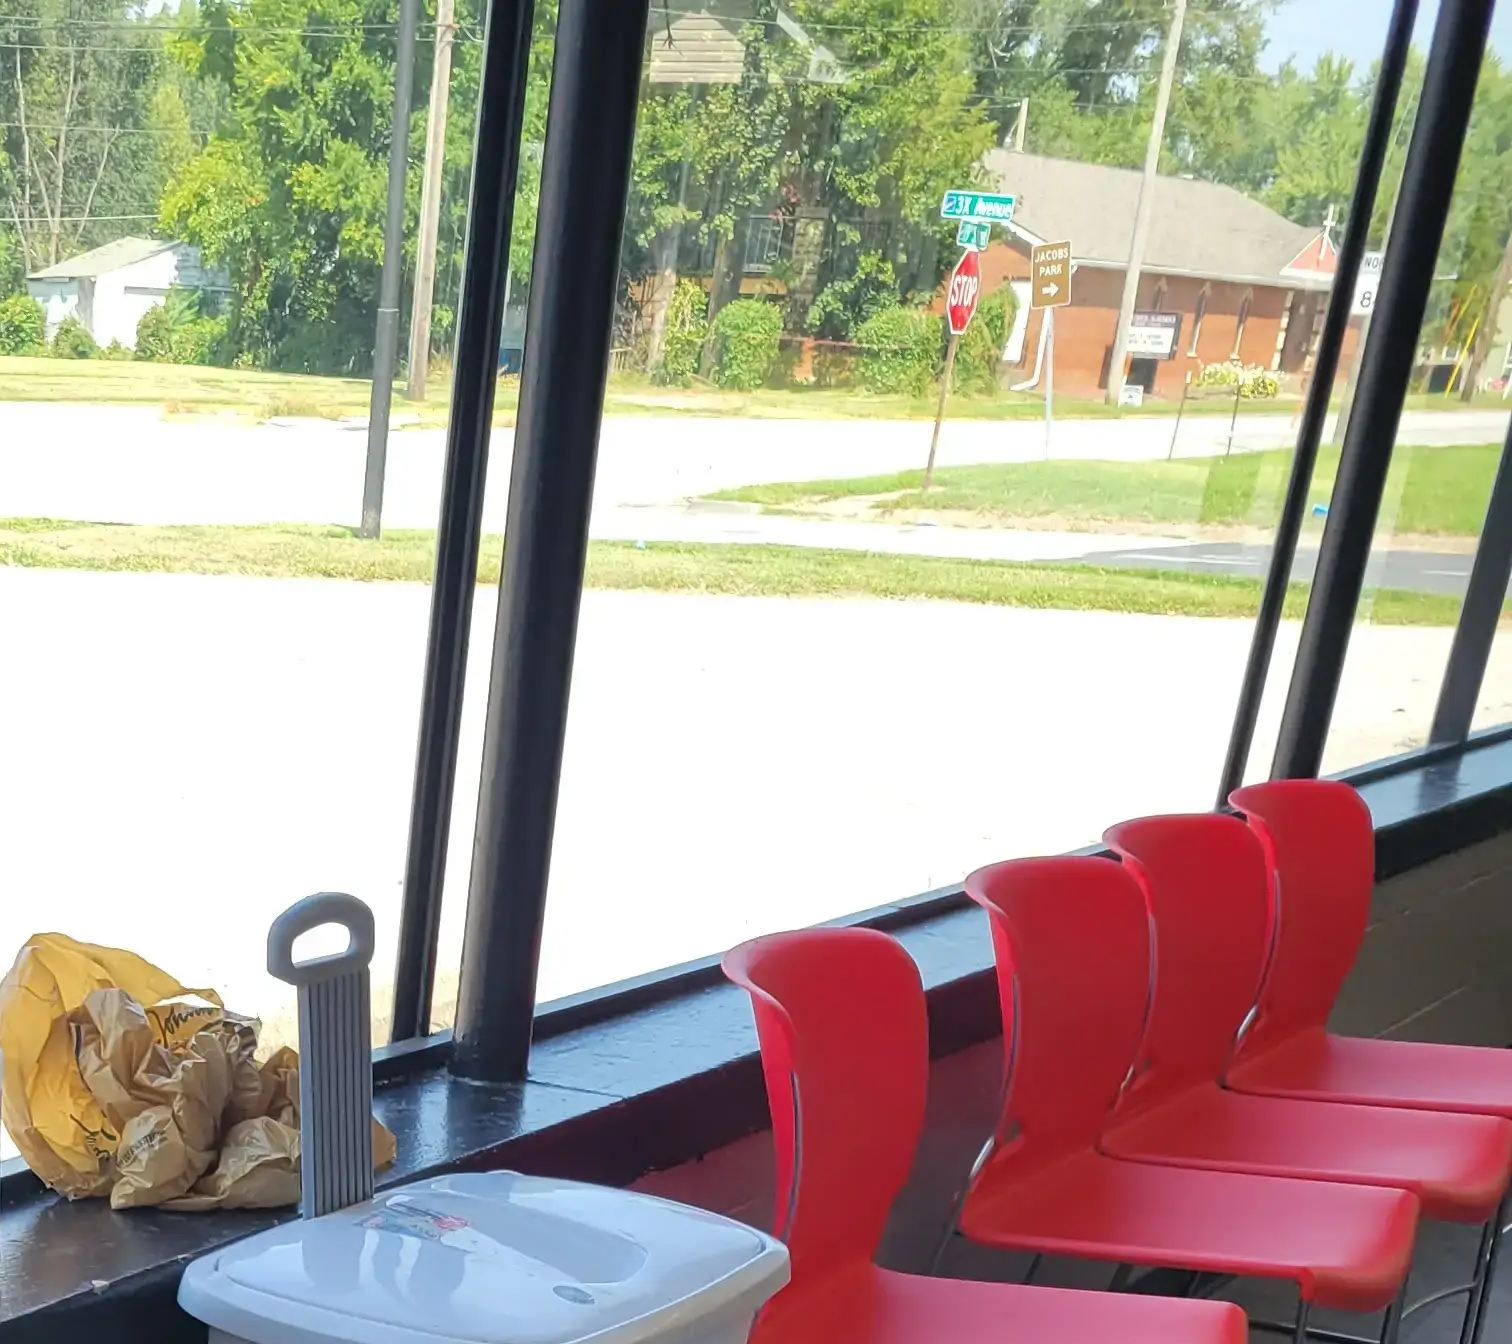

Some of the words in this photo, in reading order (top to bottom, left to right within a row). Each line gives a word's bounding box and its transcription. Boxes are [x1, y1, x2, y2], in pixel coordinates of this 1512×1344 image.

[973, 197, 1012, 218] Avenue
[1034, 247, 1069, 263] JACOBS
[1039, 263, 1063, 278] PARK
[950, 274, 978, 307] STOP
